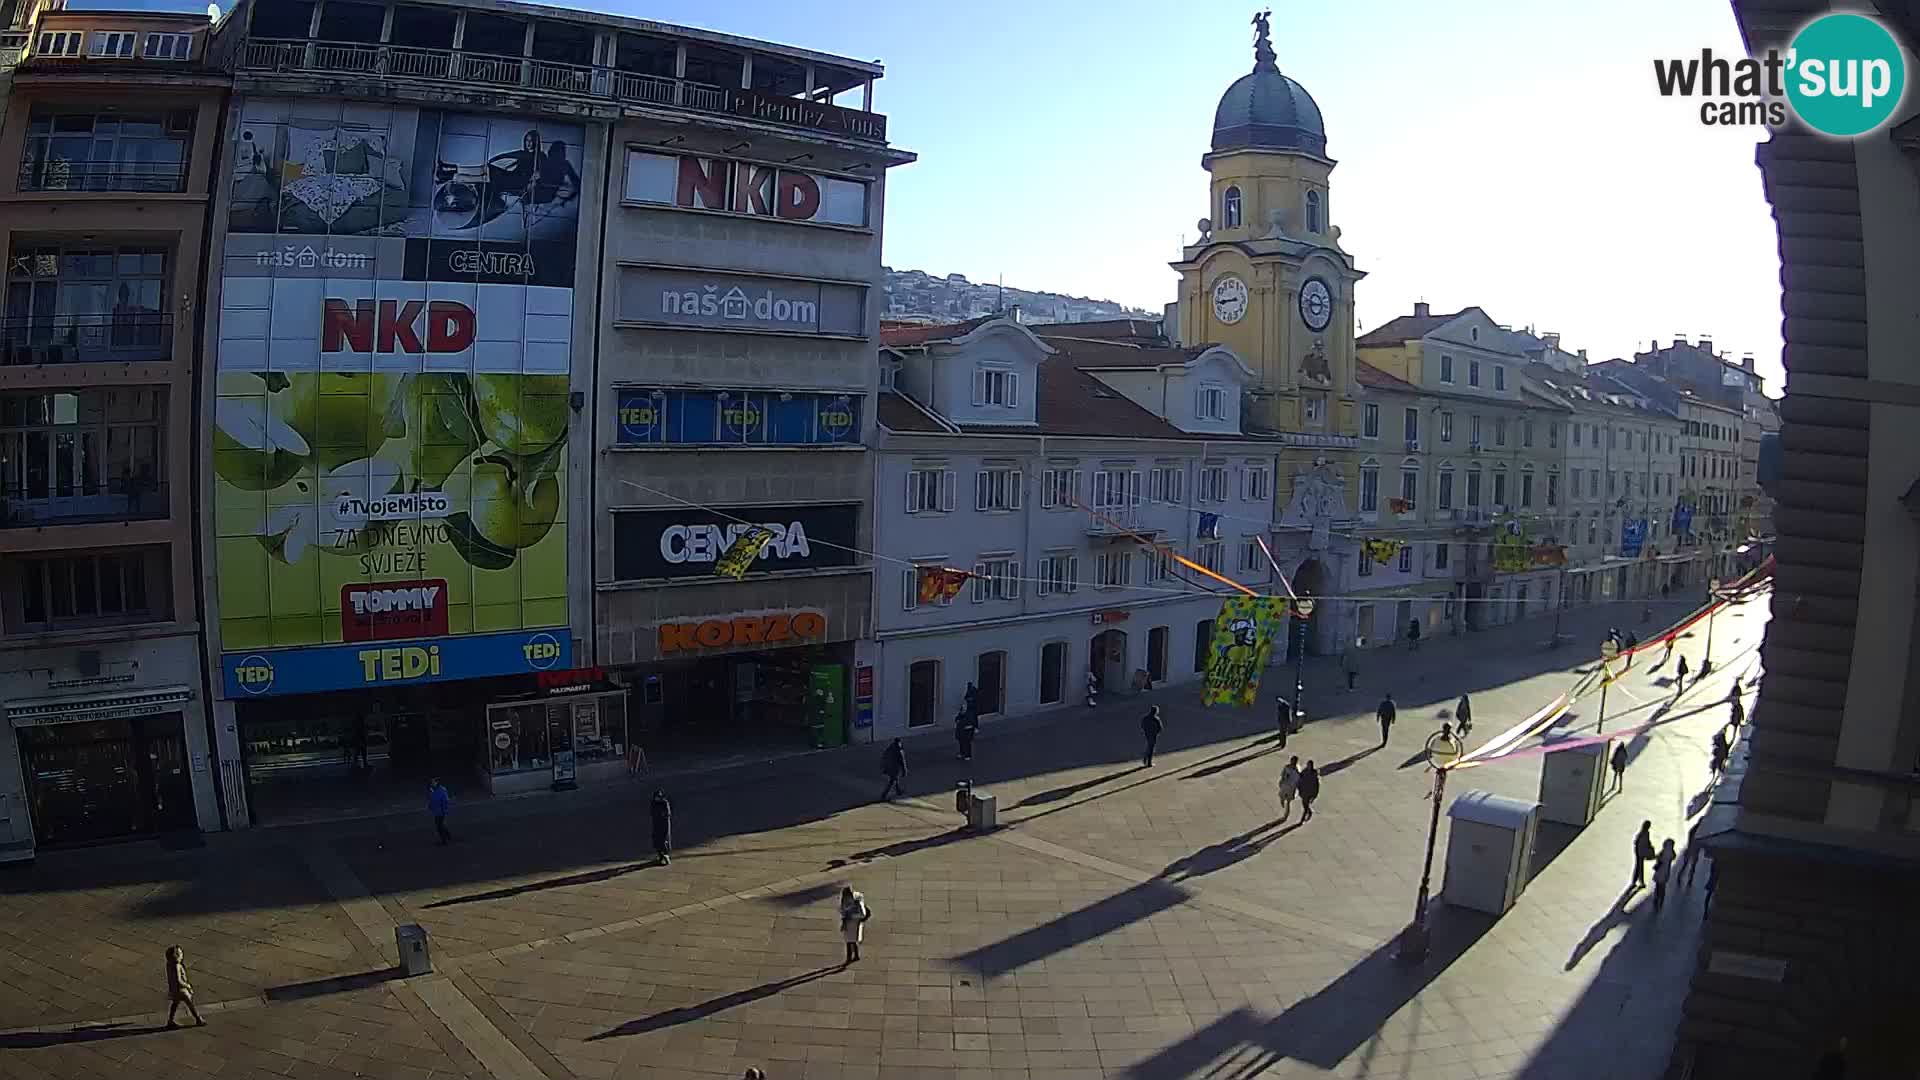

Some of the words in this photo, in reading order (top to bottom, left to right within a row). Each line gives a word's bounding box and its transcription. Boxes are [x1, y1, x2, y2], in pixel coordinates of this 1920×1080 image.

[677, 156, 821, 220] NKD
[256, 245, 295, 268] naš
[320, 247, 367, 269] dom
[449, 249, 535, 276] CENTRA
[661, 284, 719, 317] naš
[754, 289, 816, 323] dom
[321, 297, 478, 354] NKD
[619, 408, 658, 425] TEDi
[723, 409, 760, 426] TEDi
[820, 411, 853, 427] TEDi
[339, 496, 447, 516] #TvojeMisto
[334, 528, 359, 549] ZA
[367, 523, 450, 548] DNEVNO
[359, 547, 428, 575] SVJEŽE
[349, 586, 440, 615] TOMMY
[659, 611, 826, 656] KORZO
[522, 640, 561, 660] TEDi
[234, 665, 274, 683] TEDi
[359, 645, 441, 682] TEDi
